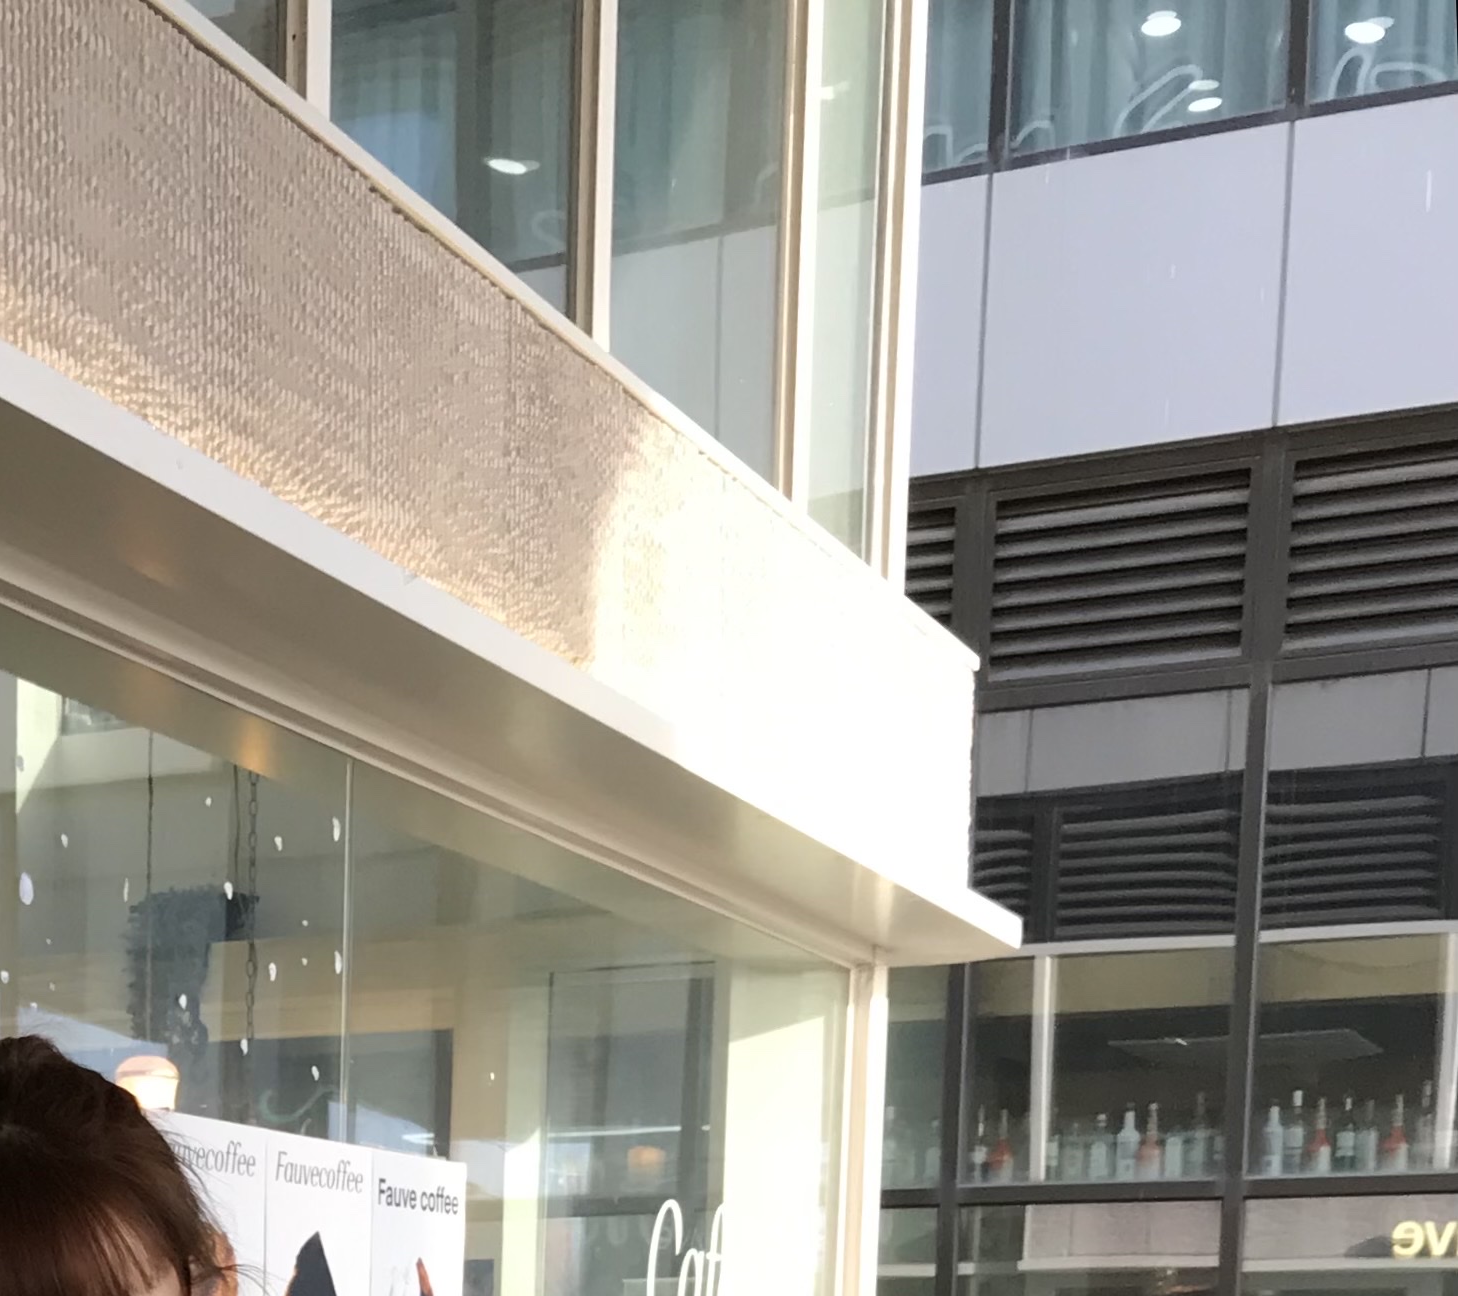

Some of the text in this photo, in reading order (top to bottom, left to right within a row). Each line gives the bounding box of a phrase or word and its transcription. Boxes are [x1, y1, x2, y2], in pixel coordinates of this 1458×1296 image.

[275, 1151, 363, 1193] Fauvecoffee
[378, 1178, 459, 1215] Fauve coffee
